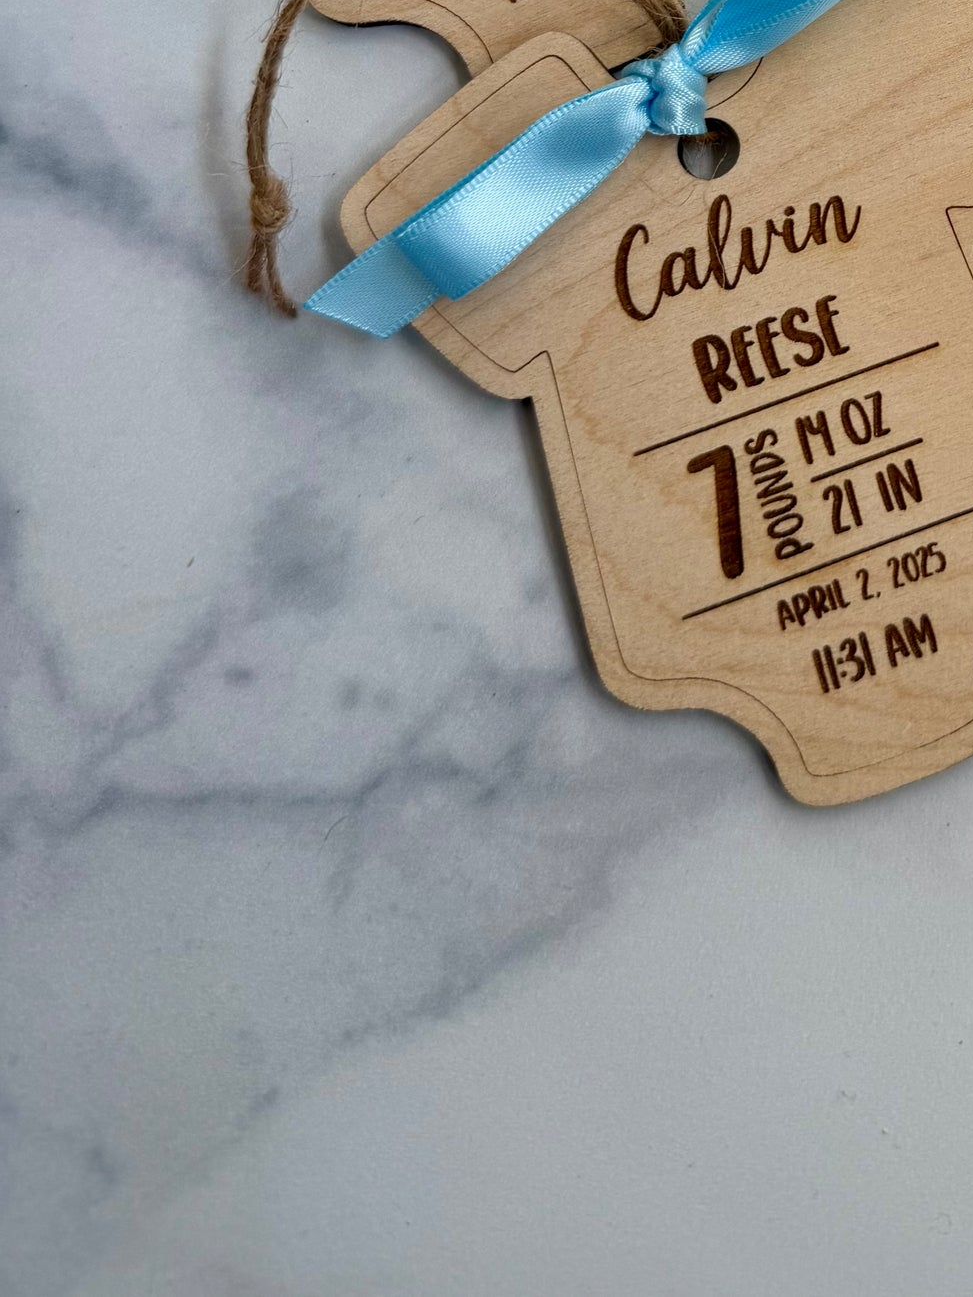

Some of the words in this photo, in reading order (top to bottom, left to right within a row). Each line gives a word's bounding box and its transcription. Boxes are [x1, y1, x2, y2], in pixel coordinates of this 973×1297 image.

[614, 194, 861, 320] Calvin
[692, 295, 850, 403] REESE
[840, 390, 891, 445] OZ
[687, 444, 744, 579] 7
[744, 428, 814, 561] POUNDS
[823, 478, 864, 534] 21
[875, 458, 923, 512] IN
[777, 579, 850, 631] APRIL
[887, 542, 947, 589] 2025
[812, 632, 876, 693] 11:31
[884, 613, 938, 667] AM
